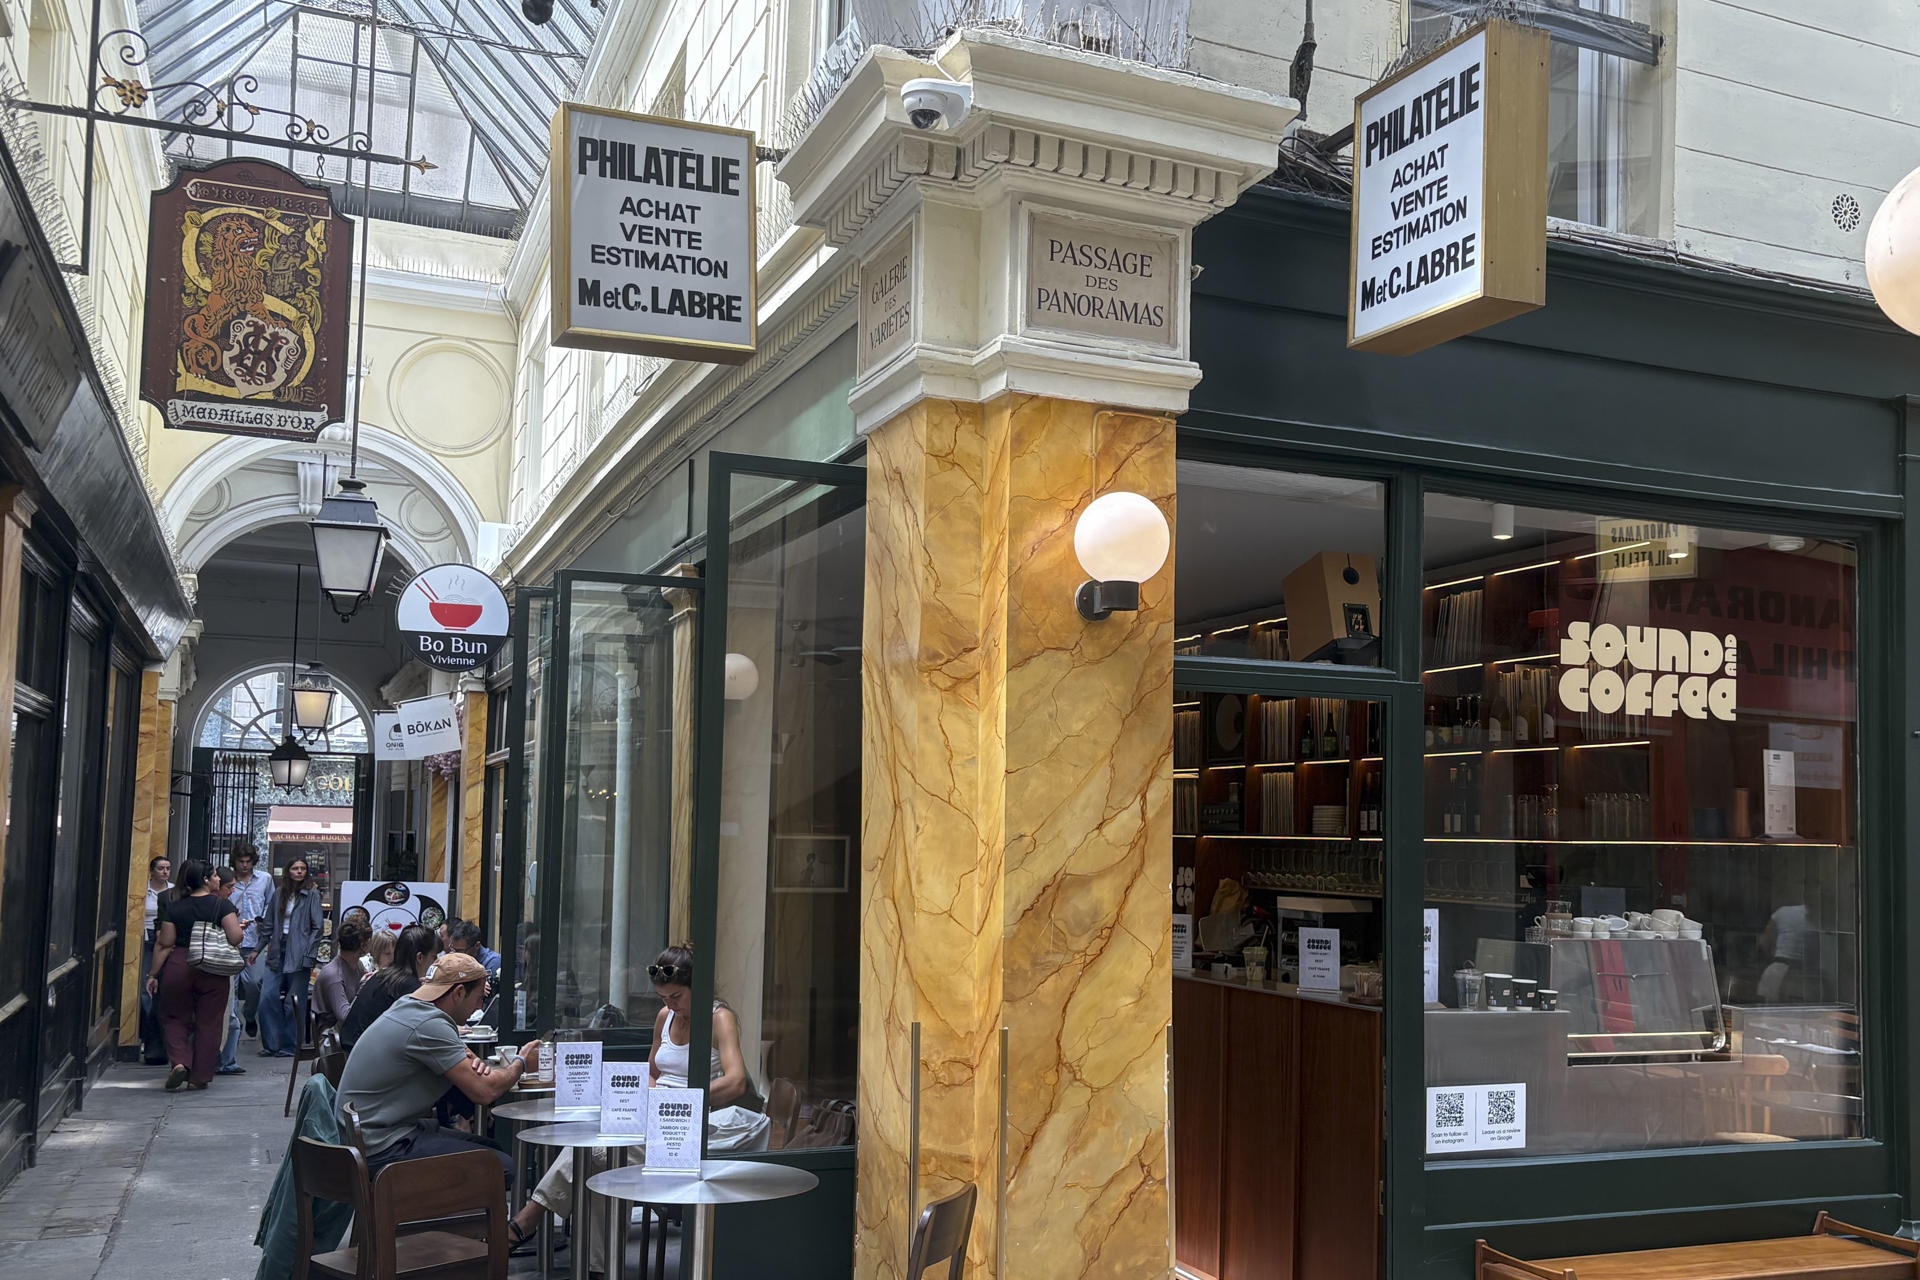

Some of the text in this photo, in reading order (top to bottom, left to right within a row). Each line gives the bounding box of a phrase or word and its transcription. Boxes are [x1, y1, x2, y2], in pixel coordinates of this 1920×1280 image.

[1365, 62, 1480, 168] PHILATÉLIE
[578, 136, 740, 196] PHILATÉLIE
[1390, 143, 1449, 193] ACHAT
[619, 196, 702, 224] ACHAT
[1390, 175, 1448, 221] VENTE
[619, 222, 702, 251] VENTE
[1371, 195, 1468, 261] ESTIMATION
[591, 244, 728, 279] ESTIMATION
[1049, 239, 1153, 278] PASSAGE
[871, 255, 908, 304] GALERIE
[1085, 274, 1119, 292] DES
[651, 286, 742, 323] LABRE
[885, 294, 897, 312] DES
[1037, 287, 1164, 328] PANORAMAS
[419, 635, 488, 654] Bo Bun
[430, 654, 476, 666] Vivienne
[1560, 621, 1724, 675] SOUND
[1558, 667, 1737, 722] COFFEE
